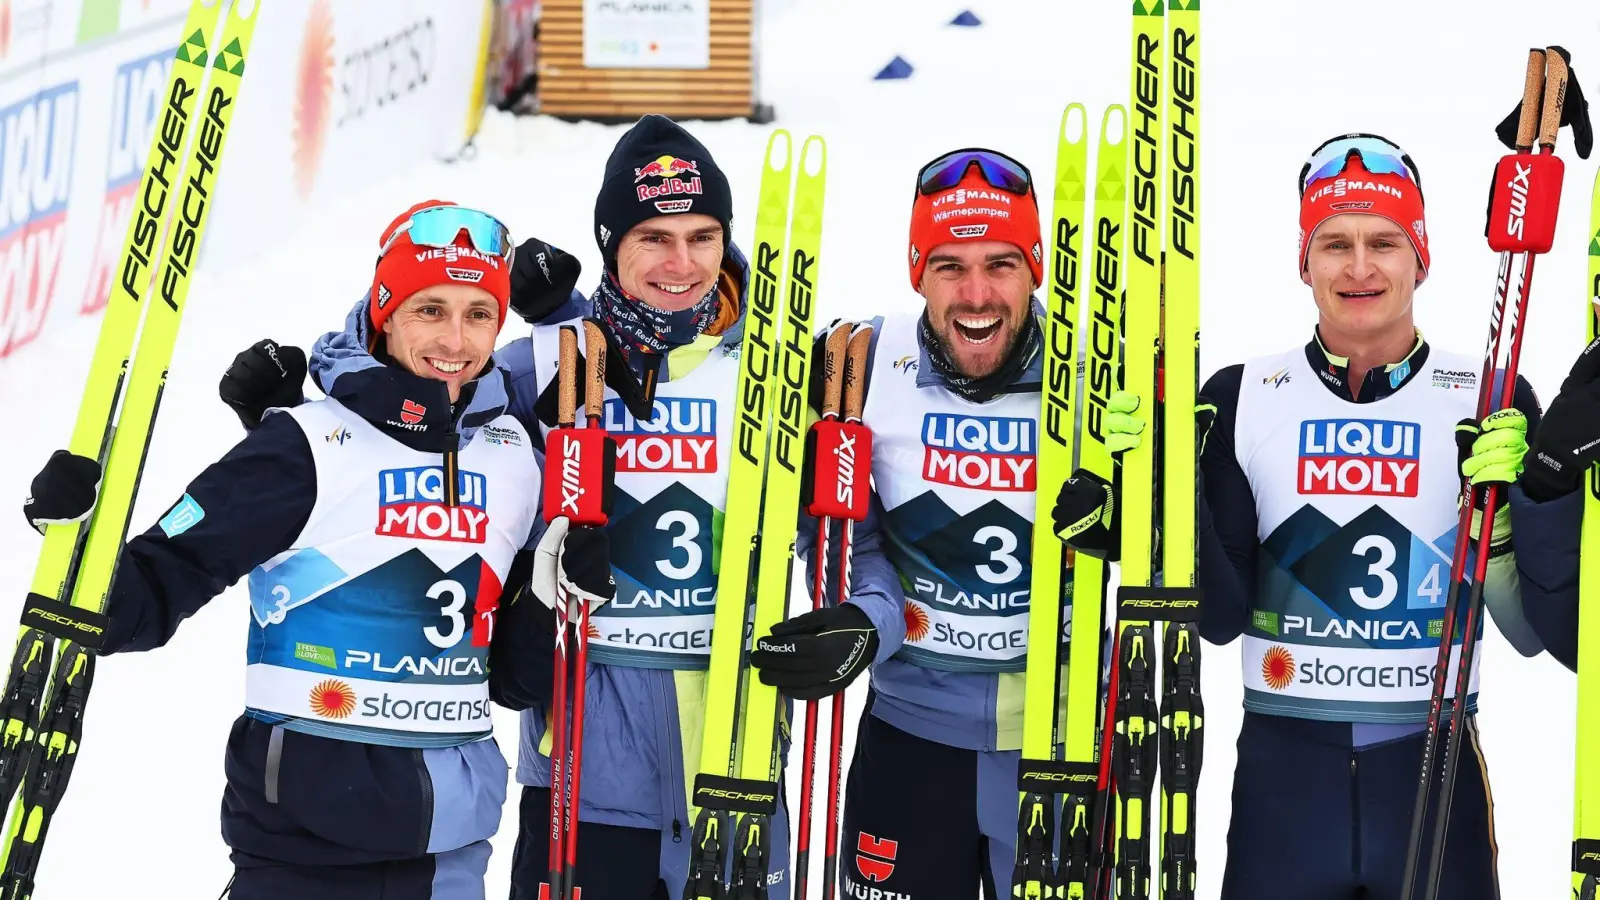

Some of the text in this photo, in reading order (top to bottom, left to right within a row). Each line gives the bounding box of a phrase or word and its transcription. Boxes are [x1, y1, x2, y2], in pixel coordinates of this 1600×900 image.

[1133, 32, 1160, 267] FISCHER
[1172, 27, 1196, 260] FISCHER
[122, 76, 195, 302] FISCHER
[161, 86, 232, 313] FISCHER
[636, 177, 703, 202] Red Bull
[932, 188, 1011, 207] VIESSMANN
[1310, 178, 1402, 203] VIESSMANN
[933, 206, 1010, 223] Wärmepumpen
[416, 243, 499, 270] VIESSMANN
[635, 329, 652, 344] Red
[1046, 216, 1079, 448] FISCHER
[1087, 216, 1121, 446] FISCHER
[739, 241, 780, 467] FISCHER
[775, 247, 816, 475] FISCHER
[1433, 368, 1477, 378] PLANICA
[605, 400, 711, 434] LIQUI
[927, 416, 1033, 452] LIQUI
[616, 437, 715, 469] MOLY
[1305, 421, 1414, 457] LIQUI
[929, 449, 1035, 489] MOLY
[1303, 460, 1417, 494] MOLY
[385, 466, 482, 507] LIQUI
[382, 504, 486, 541] MOLY
[655, 510, 701, 580] 3
[972, 525, 1023, 585] 3
[1348, 534, 1399, 610] 3
[1416, 562, 1443, 605] 4
[270, 584, 291, 625] 3
[423, 579, 467, 648] 3
[611, 587, 718, 609] LANIC
[1120, 599, 1200, 610] FISCHER
[26, 606, 104, 637] FISCHER
[933, 622, 1028, 652] storae
[1283, 614, 1422, 640] PLANICA
[607, 627, 714, 651] storae
[760, 640, 796, 653] Roeckl
[836, 634, 866, 676] Roeckl
[344, 649, 484, 676] PLANICA
[362, 692, 490, 722] storaenso
[552, 757, 560, 792] TRIAC
[1022, 771, 1098, 783] FISCHER
[696, 786, 775, 804] FISCHER
[552, 808, 560, 840] AERO
[766, 869, 785, 885] REX
[845, 875, 911, 900] WÜRTH
